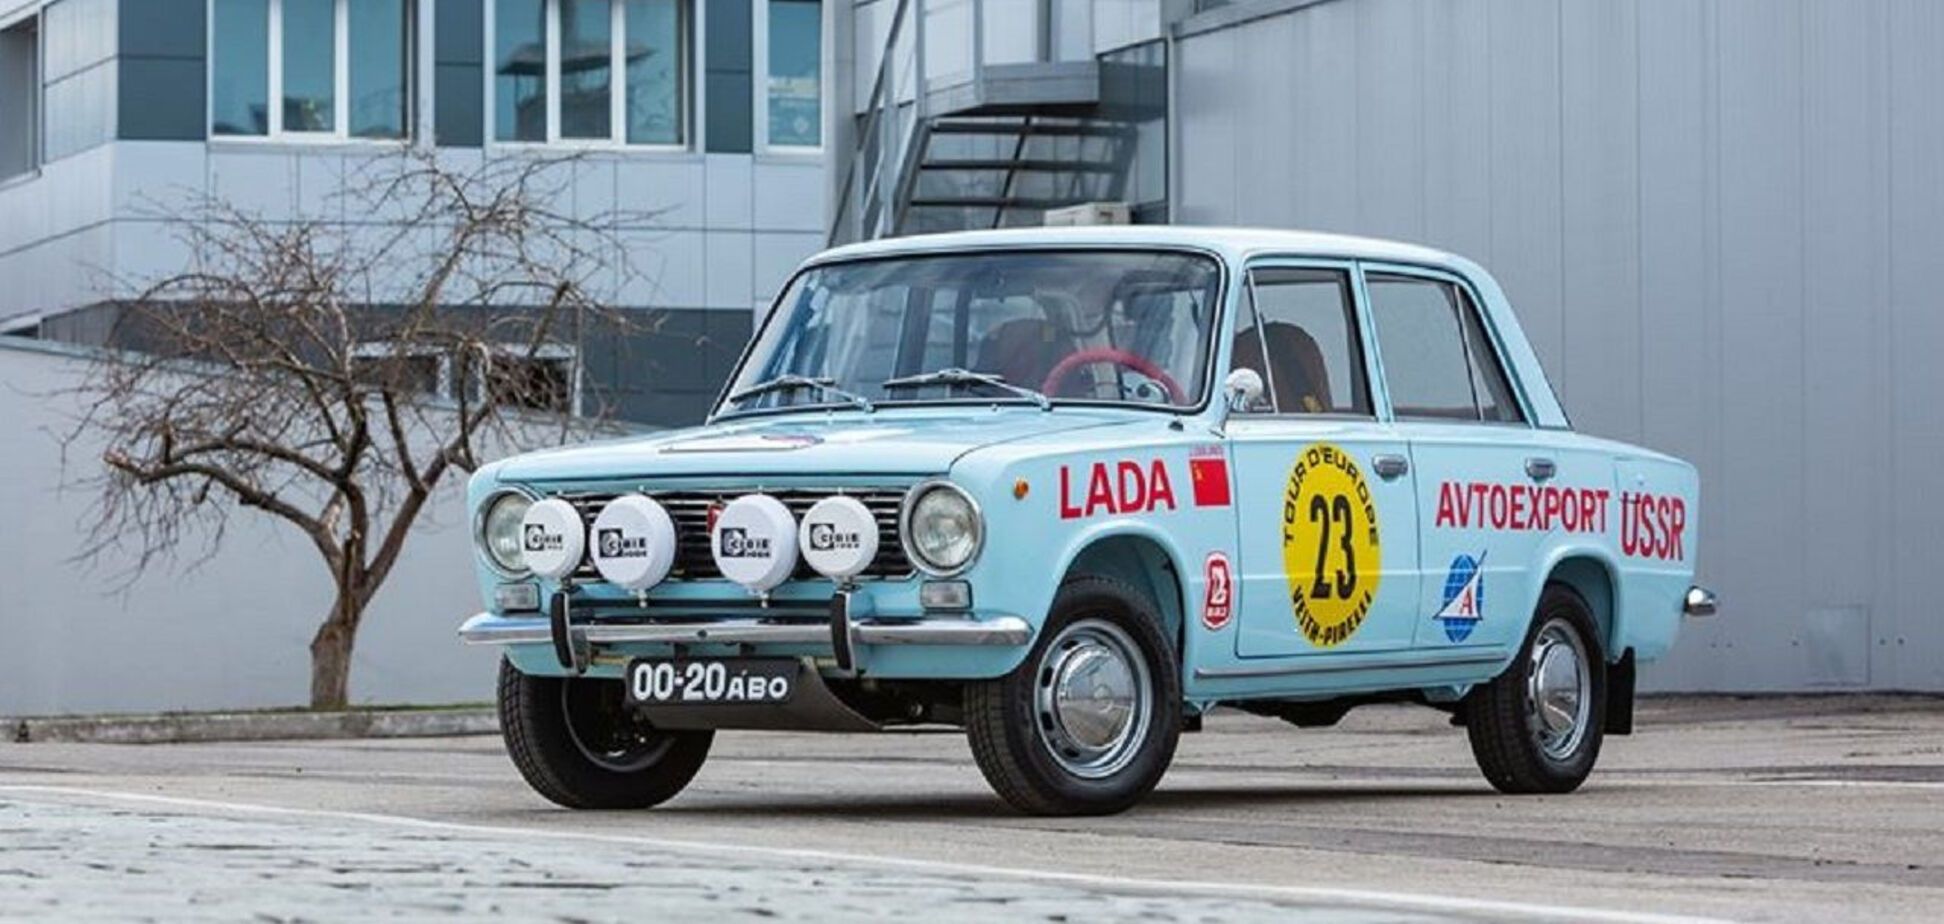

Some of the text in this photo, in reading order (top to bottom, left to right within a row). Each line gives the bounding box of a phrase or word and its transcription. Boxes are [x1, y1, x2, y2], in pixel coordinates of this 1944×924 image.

[1060, 459, 1176, 519] LADA
[1284, 446, 1379, 548] TOUR D'EUROPE
[1435, 481, 1686, 562] AVTOEXPORT USSR
[1309, 493, 1356, 601] 23
